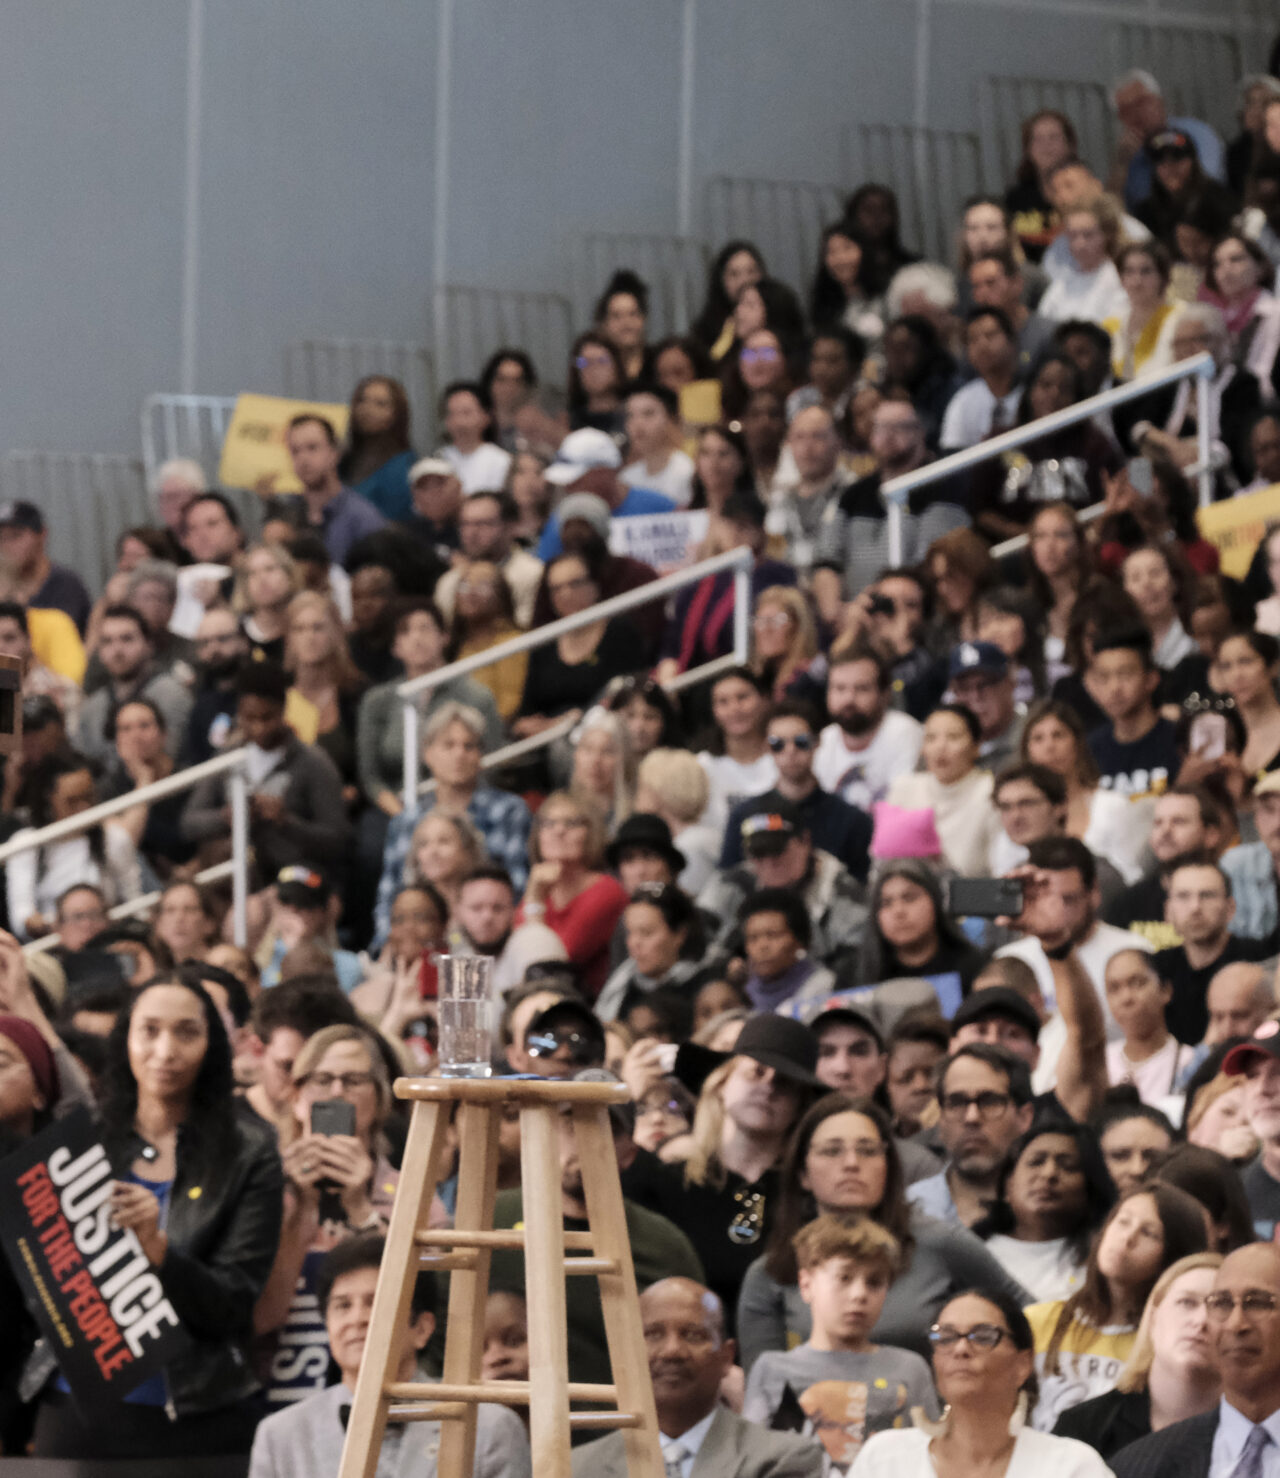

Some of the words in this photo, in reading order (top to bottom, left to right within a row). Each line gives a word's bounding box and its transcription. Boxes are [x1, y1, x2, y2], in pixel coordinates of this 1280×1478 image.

[17, 1161, 62, 1228] FOR
[38, 1213, 84, 1283] THE
[48, 1143, 180, 1358] JUSTICE
[61, 1269, 134, 1381] PEOPLE
